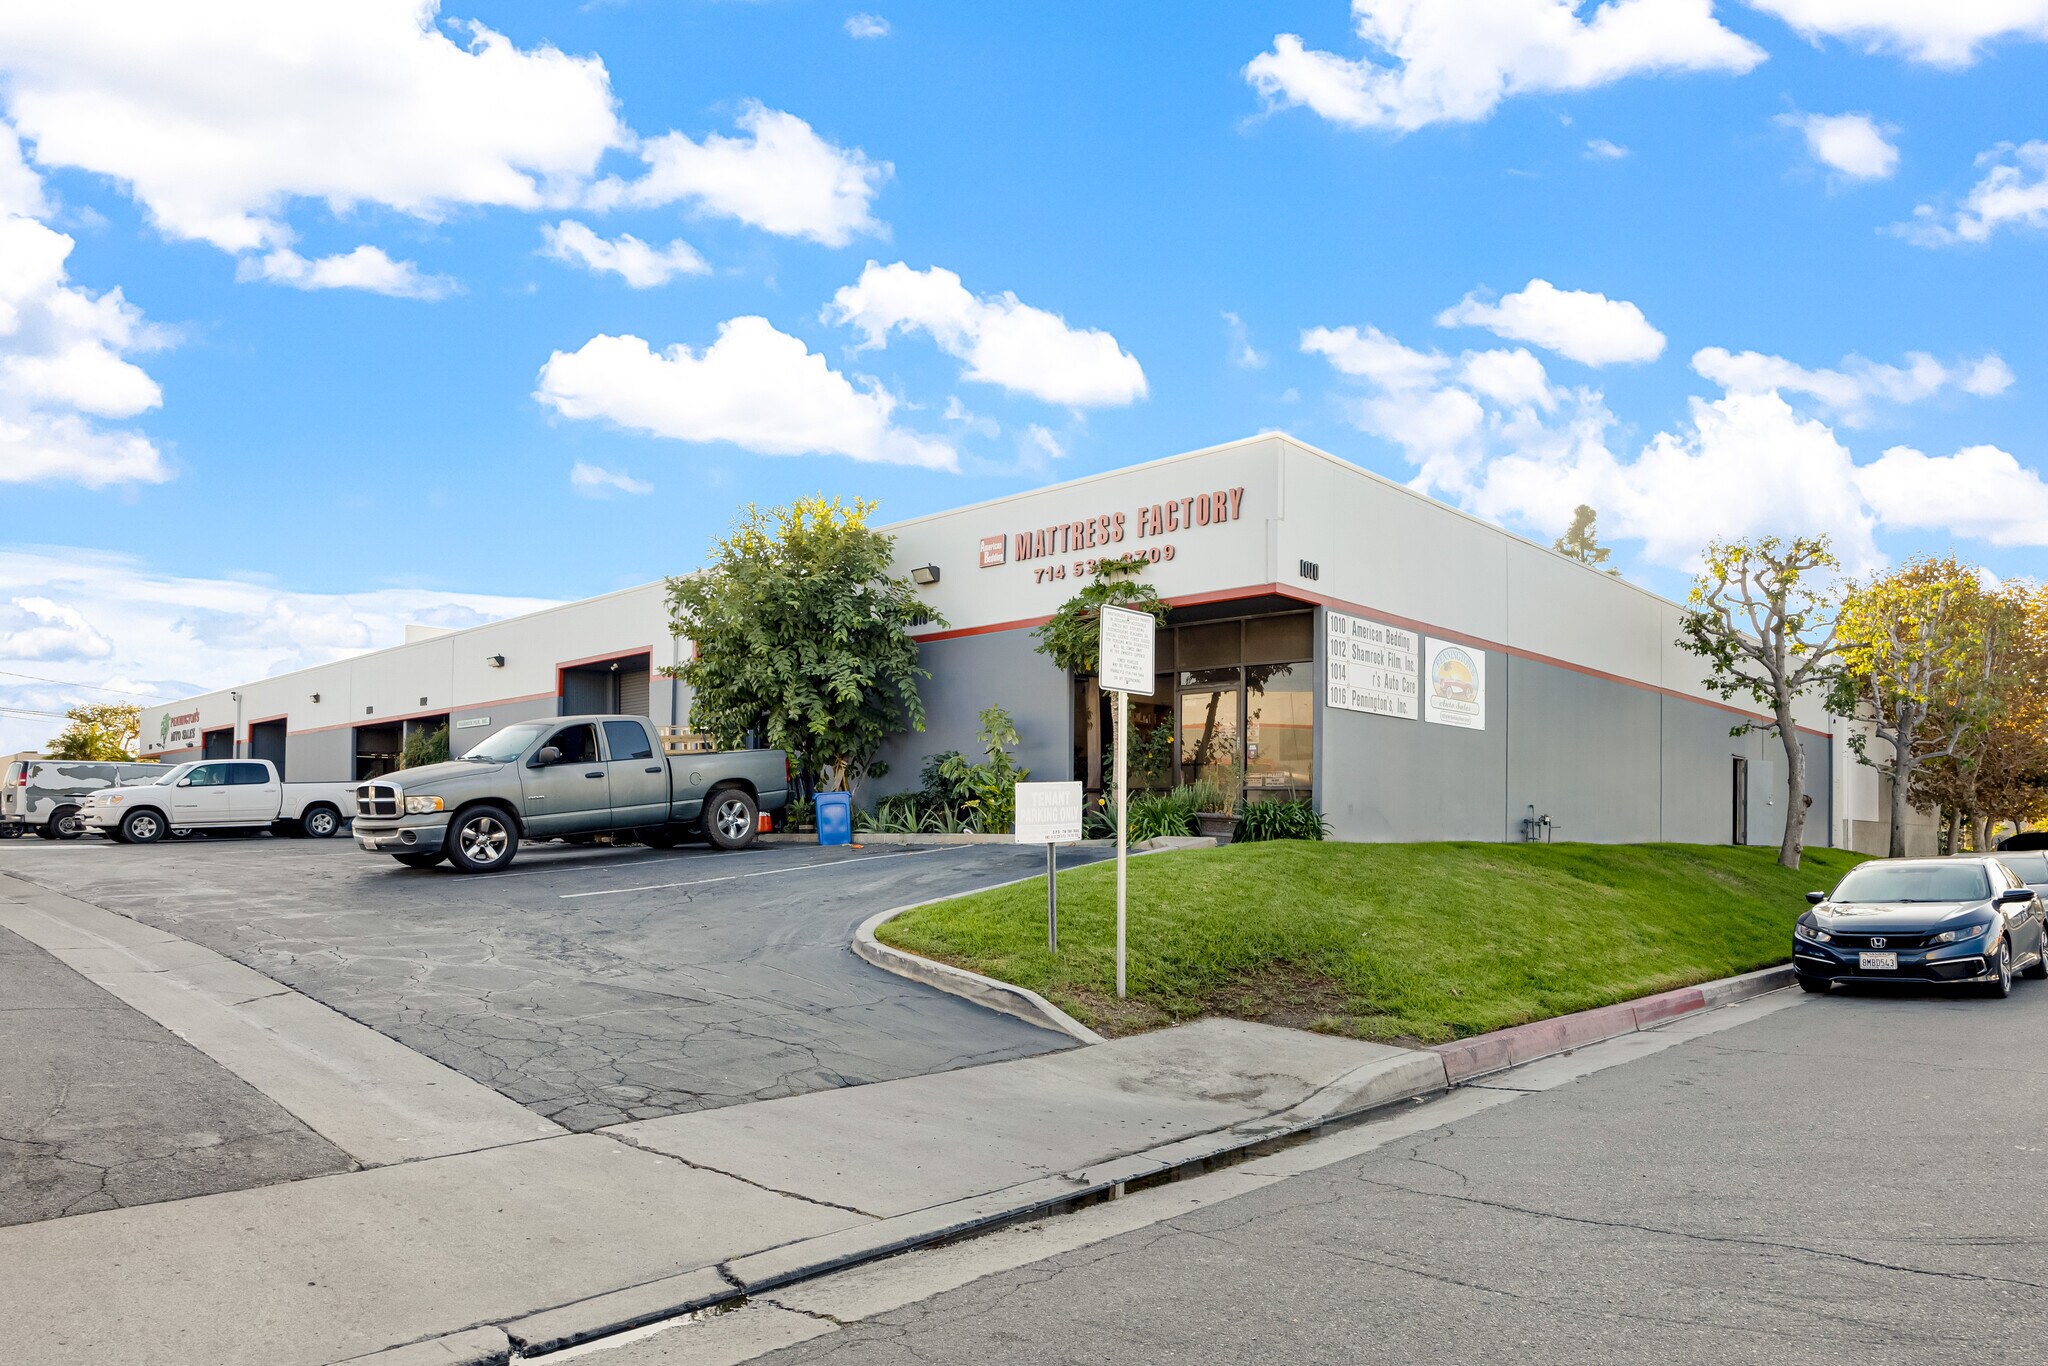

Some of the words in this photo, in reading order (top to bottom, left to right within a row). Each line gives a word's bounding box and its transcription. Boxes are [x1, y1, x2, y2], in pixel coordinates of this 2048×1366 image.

[1015, 512, 1125, 561] MATTRESS
[1137, 486, 1244, 538] FACTORY
[1034, 564, 1066, 584] 714
[1300, 559, 1319, 581] 1010
[1330, 615, 1346, 635] 1010
[1352, 620, 1383, 643] American
[1385, 628, 1410, 651] Bedding
[1330, 638, 1347, 658] 1012
[1352, 643, 1384, 666] Shamrock
[1405, 655, 1416, 672] Inc.
[1330, 662, 1346, 681] 1014
[1384, 673, 1399, 691] Auto
[1401, 676, 1416, 694] Care
[1330, 686, 1347, 705] 1016
[1397, 697, 1408, 714] Inc.
[1031, 790, 1070, 807] TENANT
[1020, 806, 1058, 823] PARKING
[1060, 805, 1079, 822] ONLY
